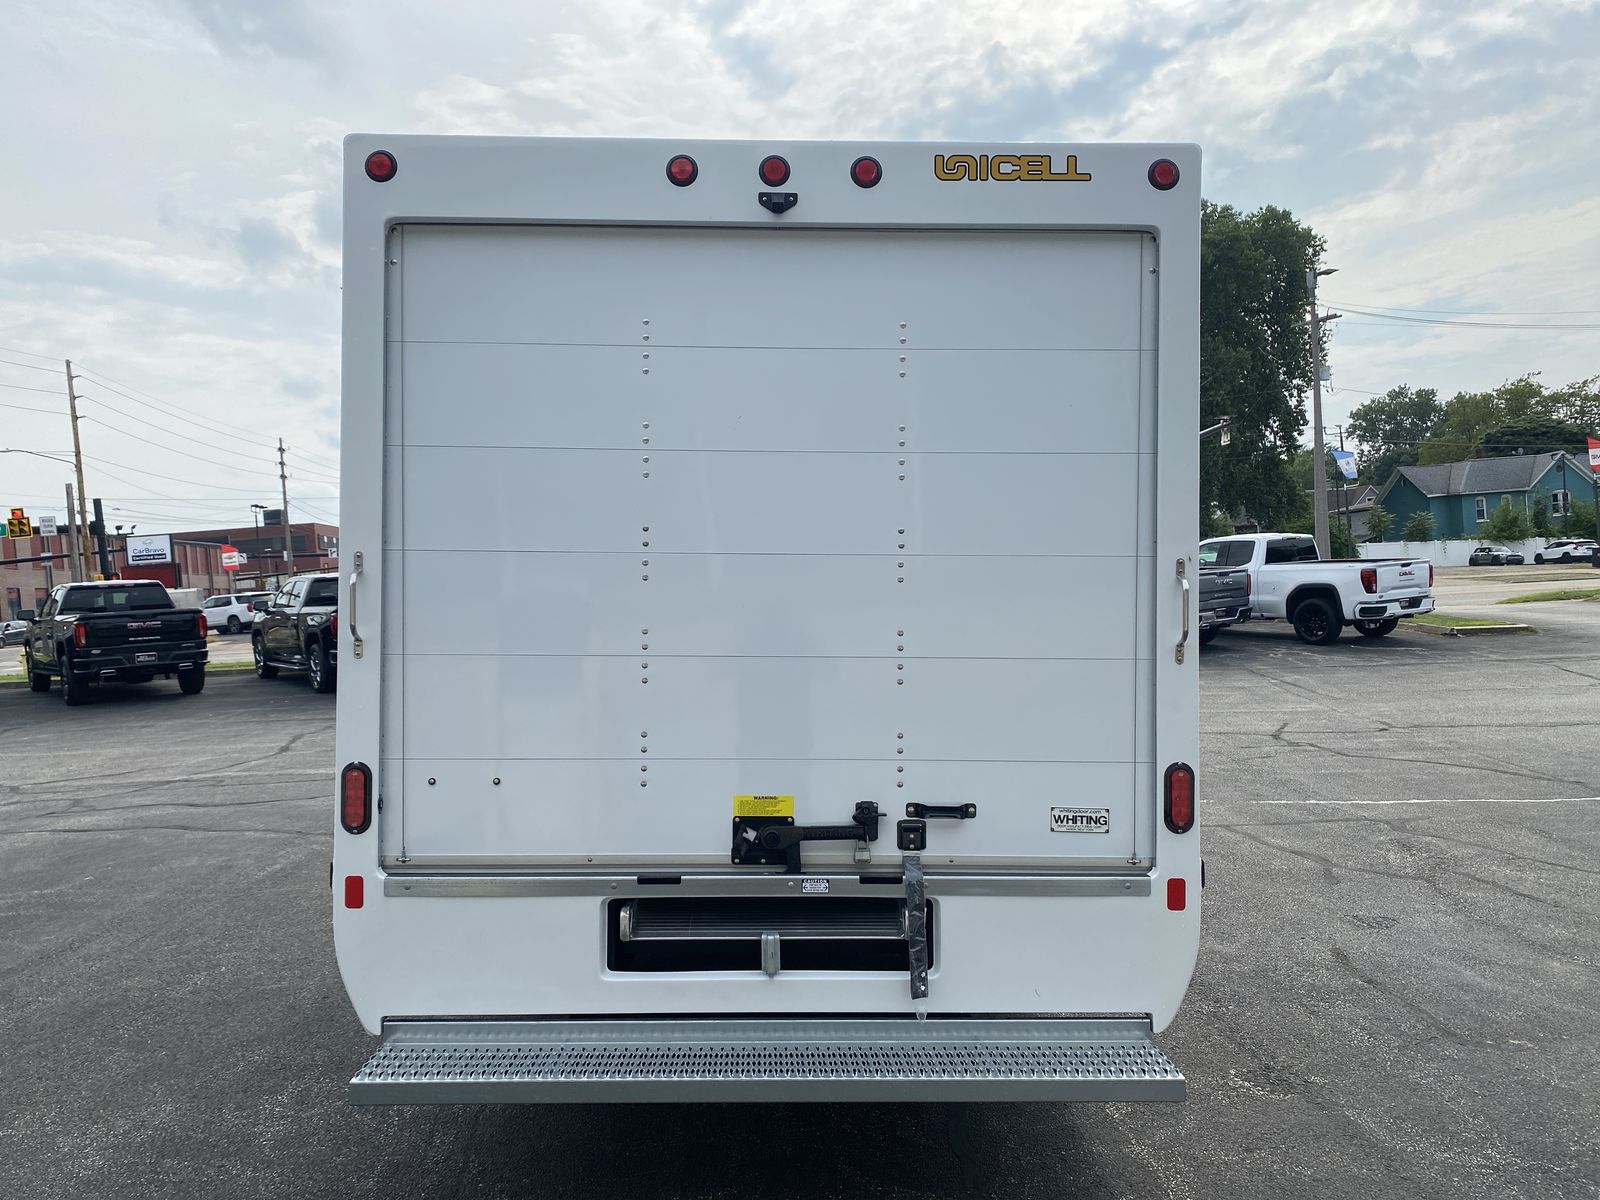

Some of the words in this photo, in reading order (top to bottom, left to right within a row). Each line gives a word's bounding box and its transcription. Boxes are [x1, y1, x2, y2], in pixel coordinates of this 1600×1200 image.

[934, 154, 1092, 181] UNICELL
[132, 547, 165, 555] CarBravo
[127, 621, 162, 629] GMC
[1053, 814, 1108, 826] WHITING
